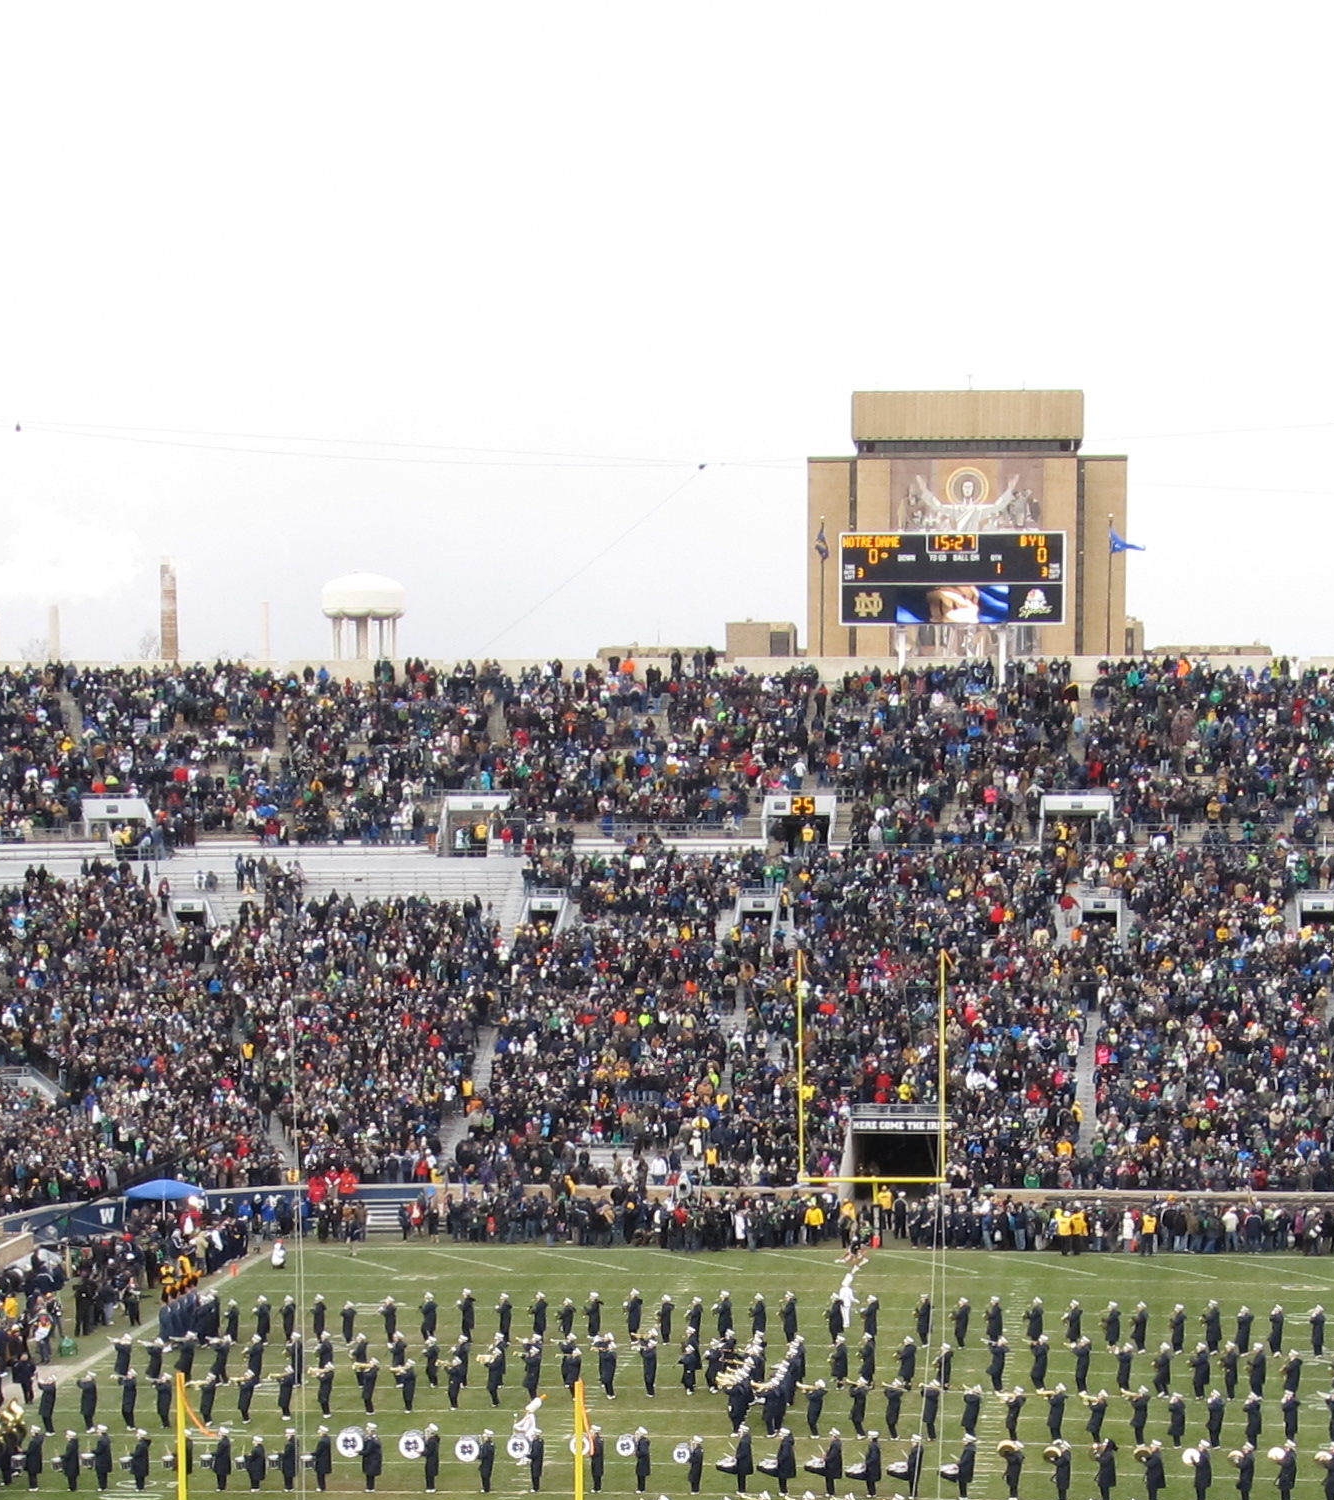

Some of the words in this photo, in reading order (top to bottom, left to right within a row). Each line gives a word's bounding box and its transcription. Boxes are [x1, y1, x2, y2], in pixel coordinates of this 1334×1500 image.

[842, 536, 873, 548] NOTRE
[874, 536, 900, 548] DAME
[934, 535, 976, 551] 15:27
[1020, 535, 1045, 547] BYU
[868, 549, 879, 564] 0
[1037, 547, 1047, 563] 0
[792, 797, 814, 814] 25
[853, 1121, 877, 1130] HERE
[879, 1121, 905, 1130] COME
[906, 1121, 926, 1130] THE
[99, 1208, 115, 1224] W
